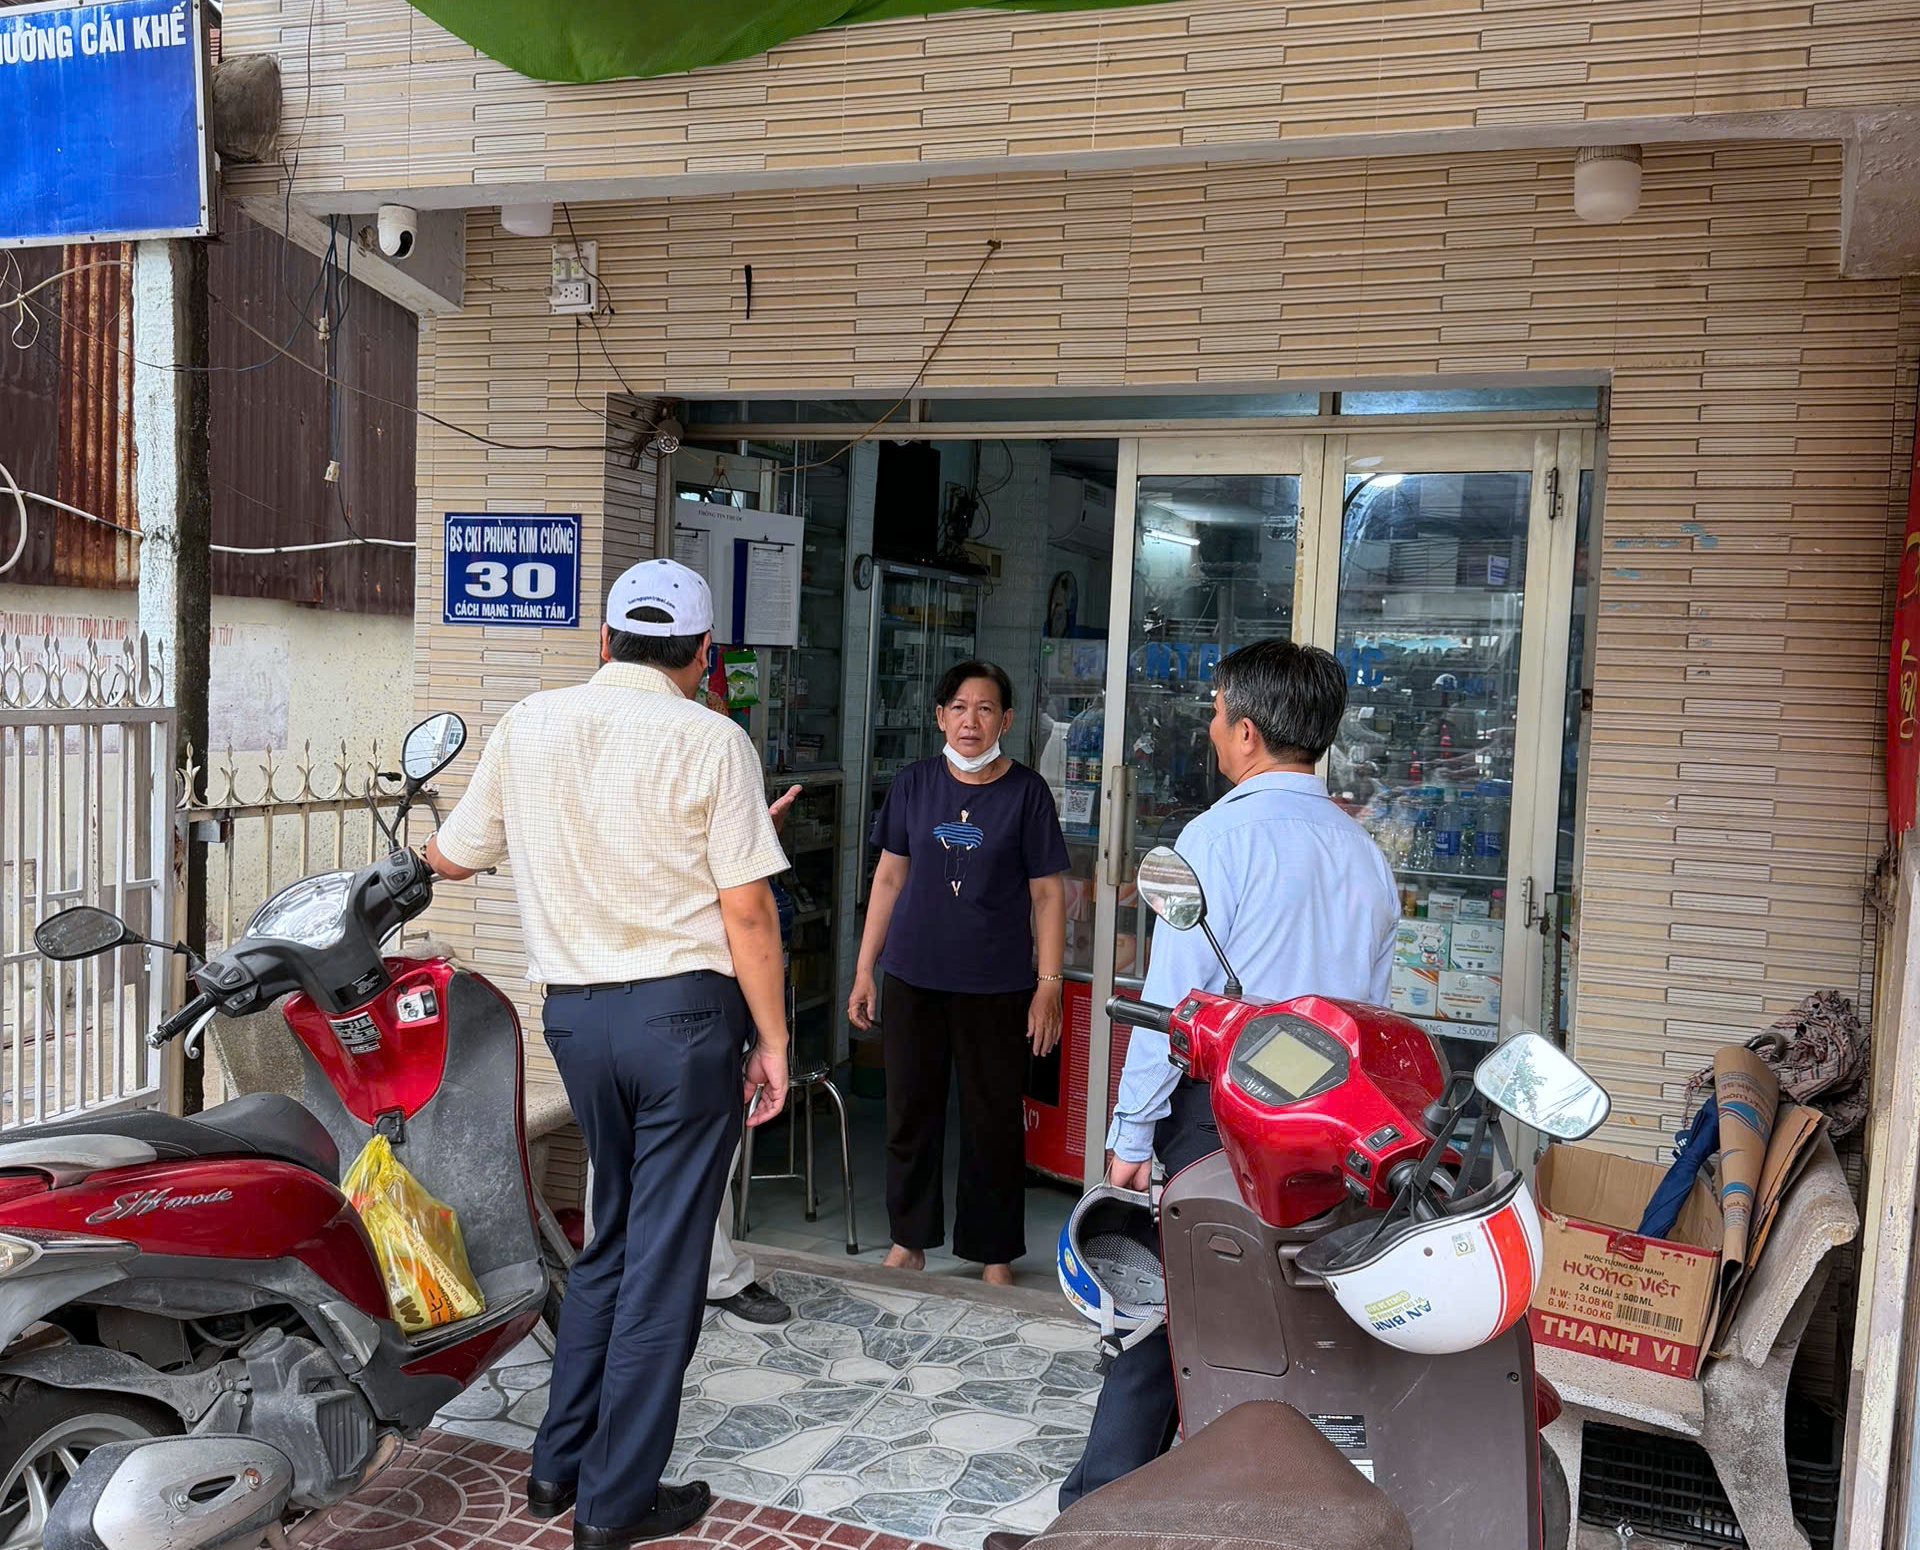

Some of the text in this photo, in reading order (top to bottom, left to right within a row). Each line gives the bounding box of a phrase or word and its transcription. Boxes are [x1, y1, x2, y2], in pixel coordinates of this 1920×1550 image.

[0, 1, 187, 65] ƯỜNG CÁI KHẾ
[449, 525, 463, 552] BS
[465, 525, 481, 553] CKI
[484, 519, 517, 553] PHÙNG
[519, 526, 538, 553] KIM
[464, 561, 556, 599] 30
[455, 600, 566, 619] CÁCH MẠNG THÁNG TÁM
[164, 1188, 233, 1210] mode
[1550, 1287, 1614, 1310] N.W: 13.08 KG
[1579, 1282, 1590, 1292] 24
[1592, 1285, 1613, 1298] CHAI
[1638, 1276, 1681, 1299] VIỆT
[1406, 1300, 1432, 1320] AN
[1548, 1298, 1612, 1320] G.W: 14.00 KG
[1540, 1314, 1640, 1356] THANH
[1652, 1341, 1680, 1371] VỊ
